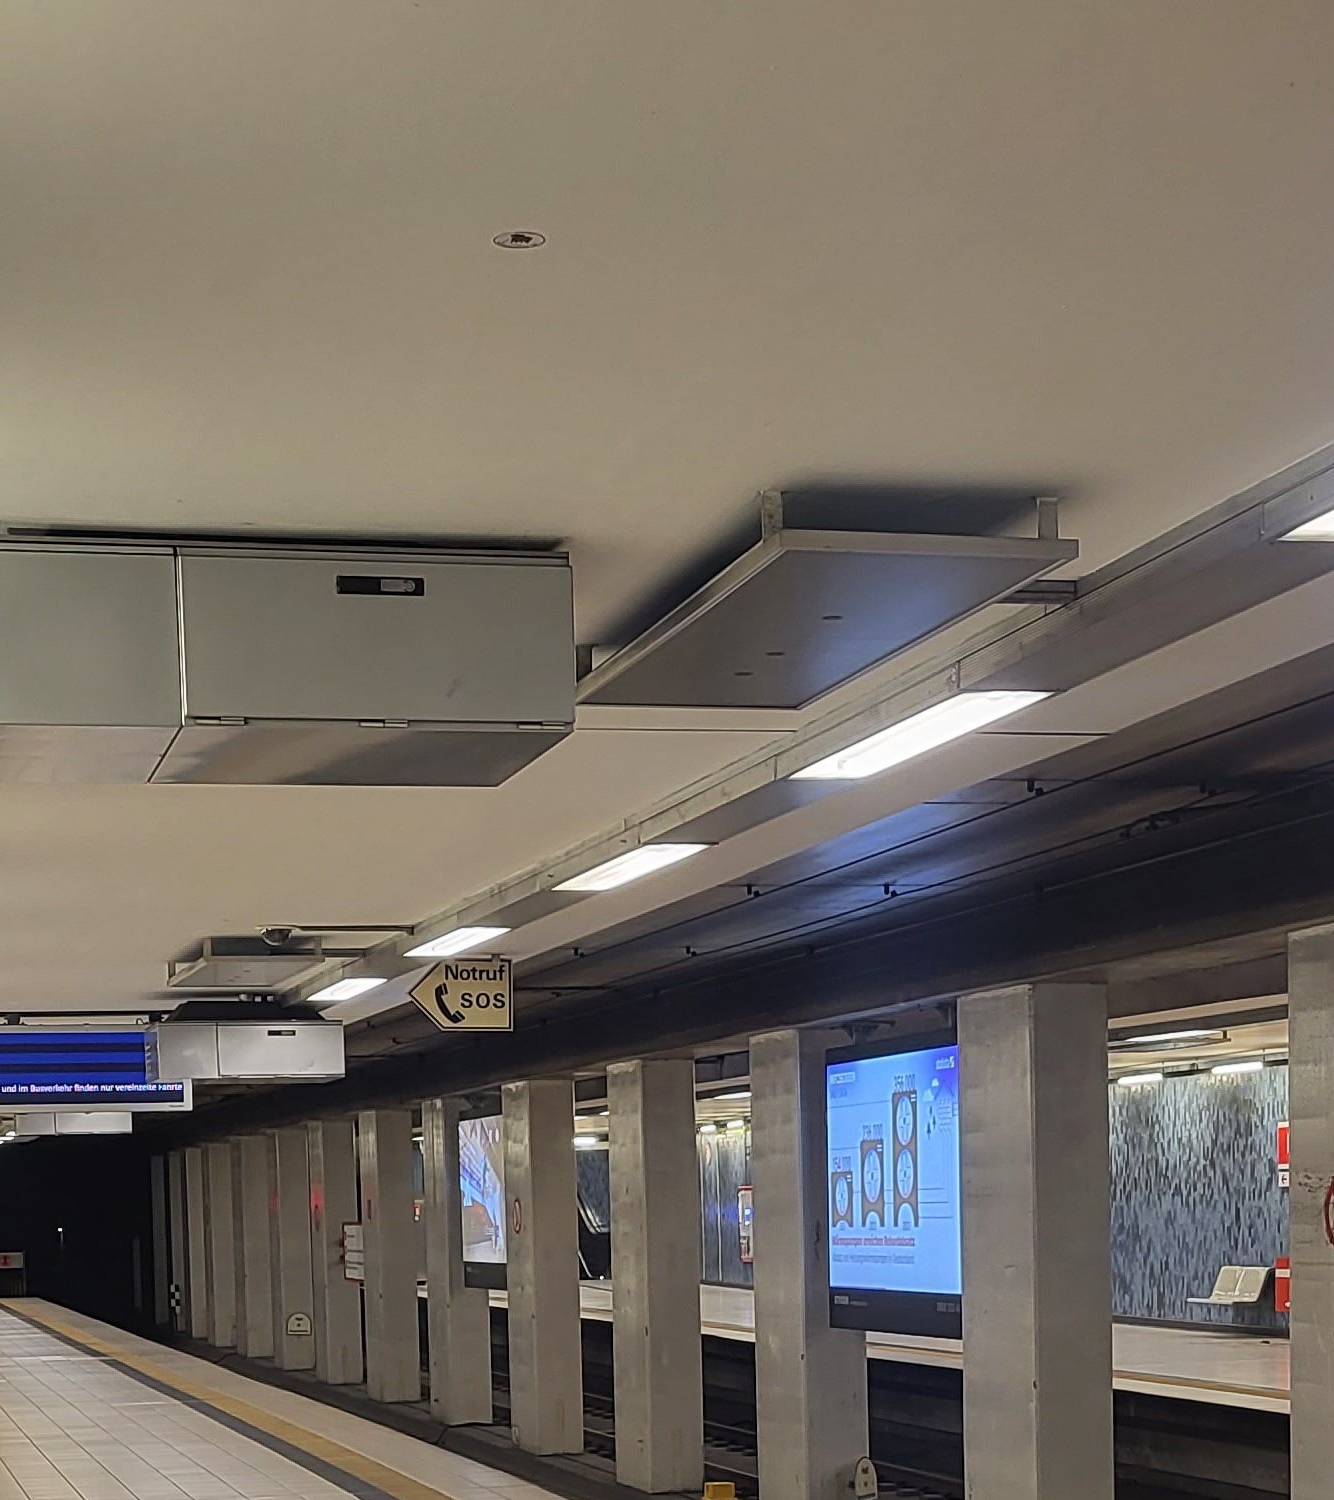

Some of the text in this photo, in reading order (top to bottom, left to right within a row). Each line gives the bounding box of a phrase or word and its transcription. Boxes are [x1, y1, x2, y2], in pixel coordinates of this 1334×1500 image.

[444, 964, 505, 981] Notruf
[460, 991, 506, 1009] SOS
[2, 1084, 17, 1093] und
[18, 1084, 29, 1093] im
[74, 1083, 99, 1092] finden
[100, 1084, 114, 1092] nur
